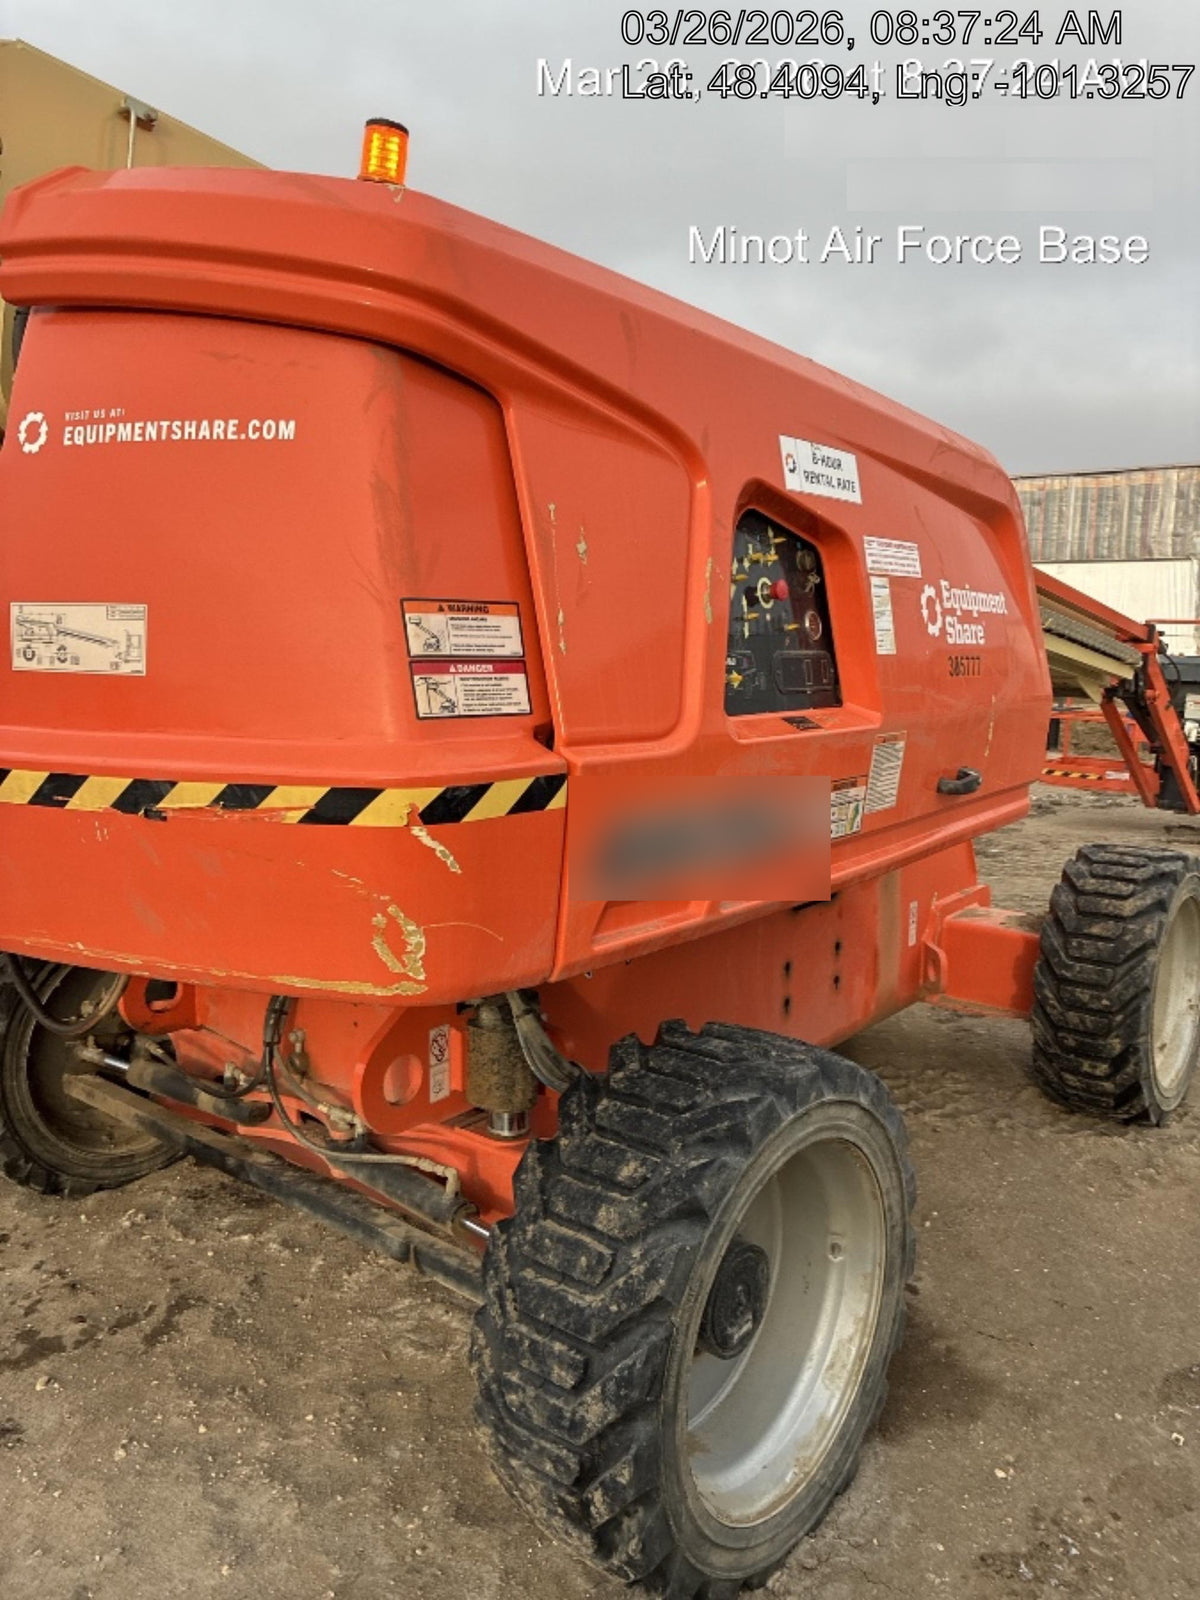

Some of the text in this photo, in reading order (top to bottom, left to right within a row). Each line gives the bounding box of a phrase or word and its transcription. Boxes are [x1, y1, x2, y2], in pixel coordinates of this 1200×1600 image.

[64, 410, 90, 421] VISIT
[93, 408, 105, 419] US
[63, 419, 296, 446] EQUIPMENTSHARE.COM
[803, 469, 856, 494] RENTAL RATE
[940, 579, 1008, 618] Equipment
[945, 615, 985, 645] Share
